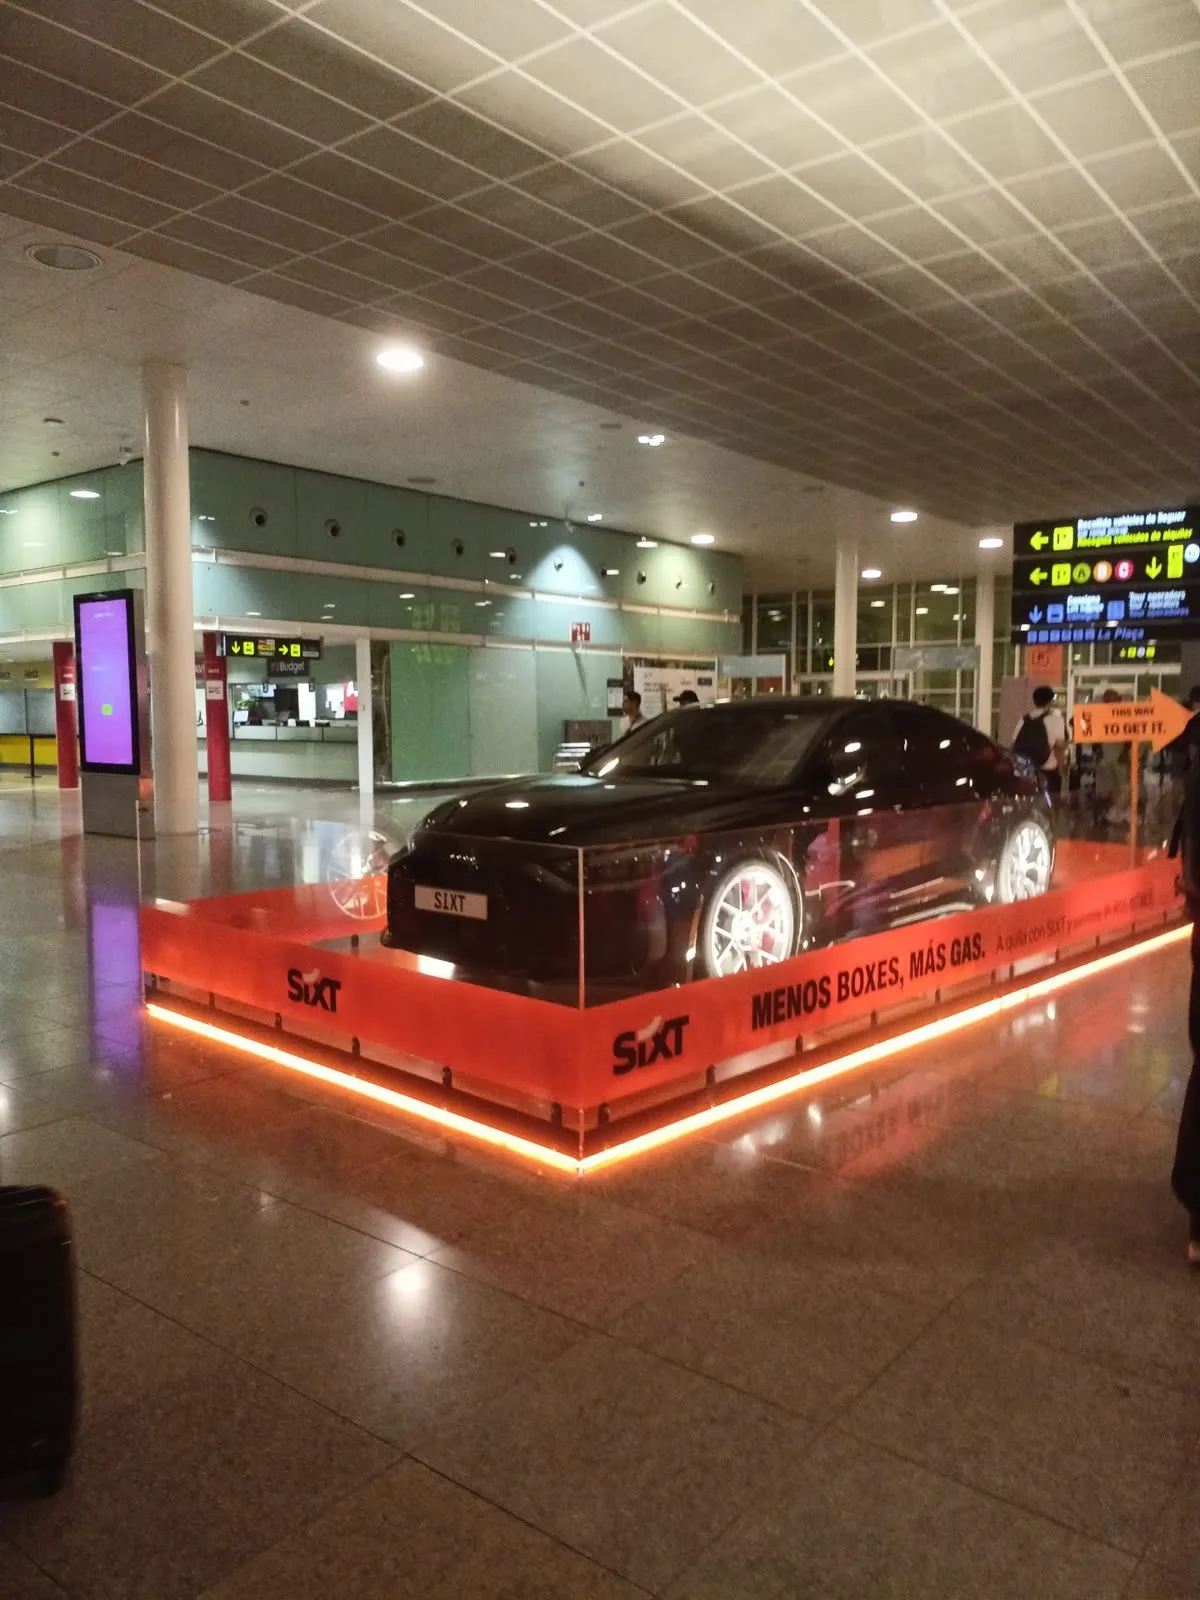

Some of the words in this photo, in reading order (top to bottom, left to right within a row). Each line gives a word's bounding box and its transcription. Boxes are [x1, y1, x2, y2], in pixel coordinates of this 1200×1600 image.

[280, 660, 305, 675] Budget
[1134, 706, 1155, 716] WAY
[1104, 723, 1119, 736] TO
[1123, 721, 1147, 735] GET
[434, 891, 466, 913] SIXT
[752, 976, 831, 1031] MENOS
[837, 957, 904, 991] BOXES,
[909, 940, 946, 980] MÁS
[950, 932, 985, 966] GAS.
